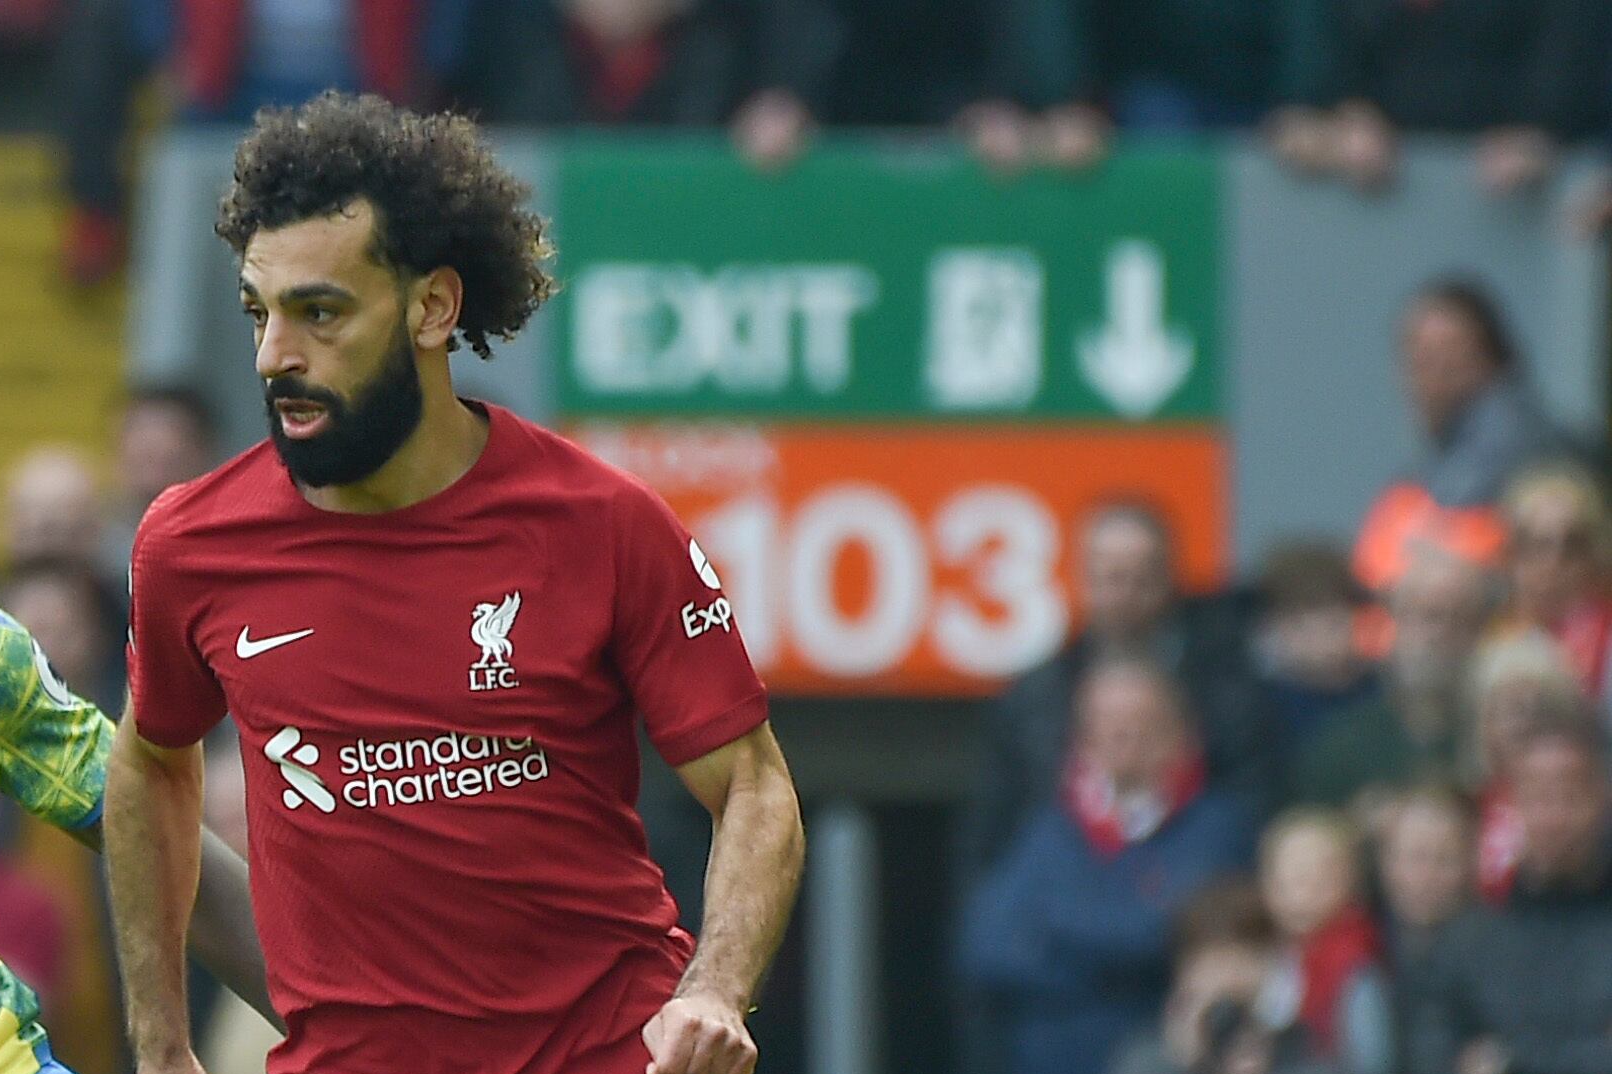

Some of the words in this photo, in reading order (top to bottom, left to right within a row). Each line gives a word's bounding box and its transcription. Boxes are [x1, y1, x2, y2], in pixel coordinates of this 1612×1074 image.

[572, 262, 876, 394] EXIT
[682, 597, 731, 638] Exp
[694, 482, 1068, 680] 103
[343, 750, 549, 808] chartered
